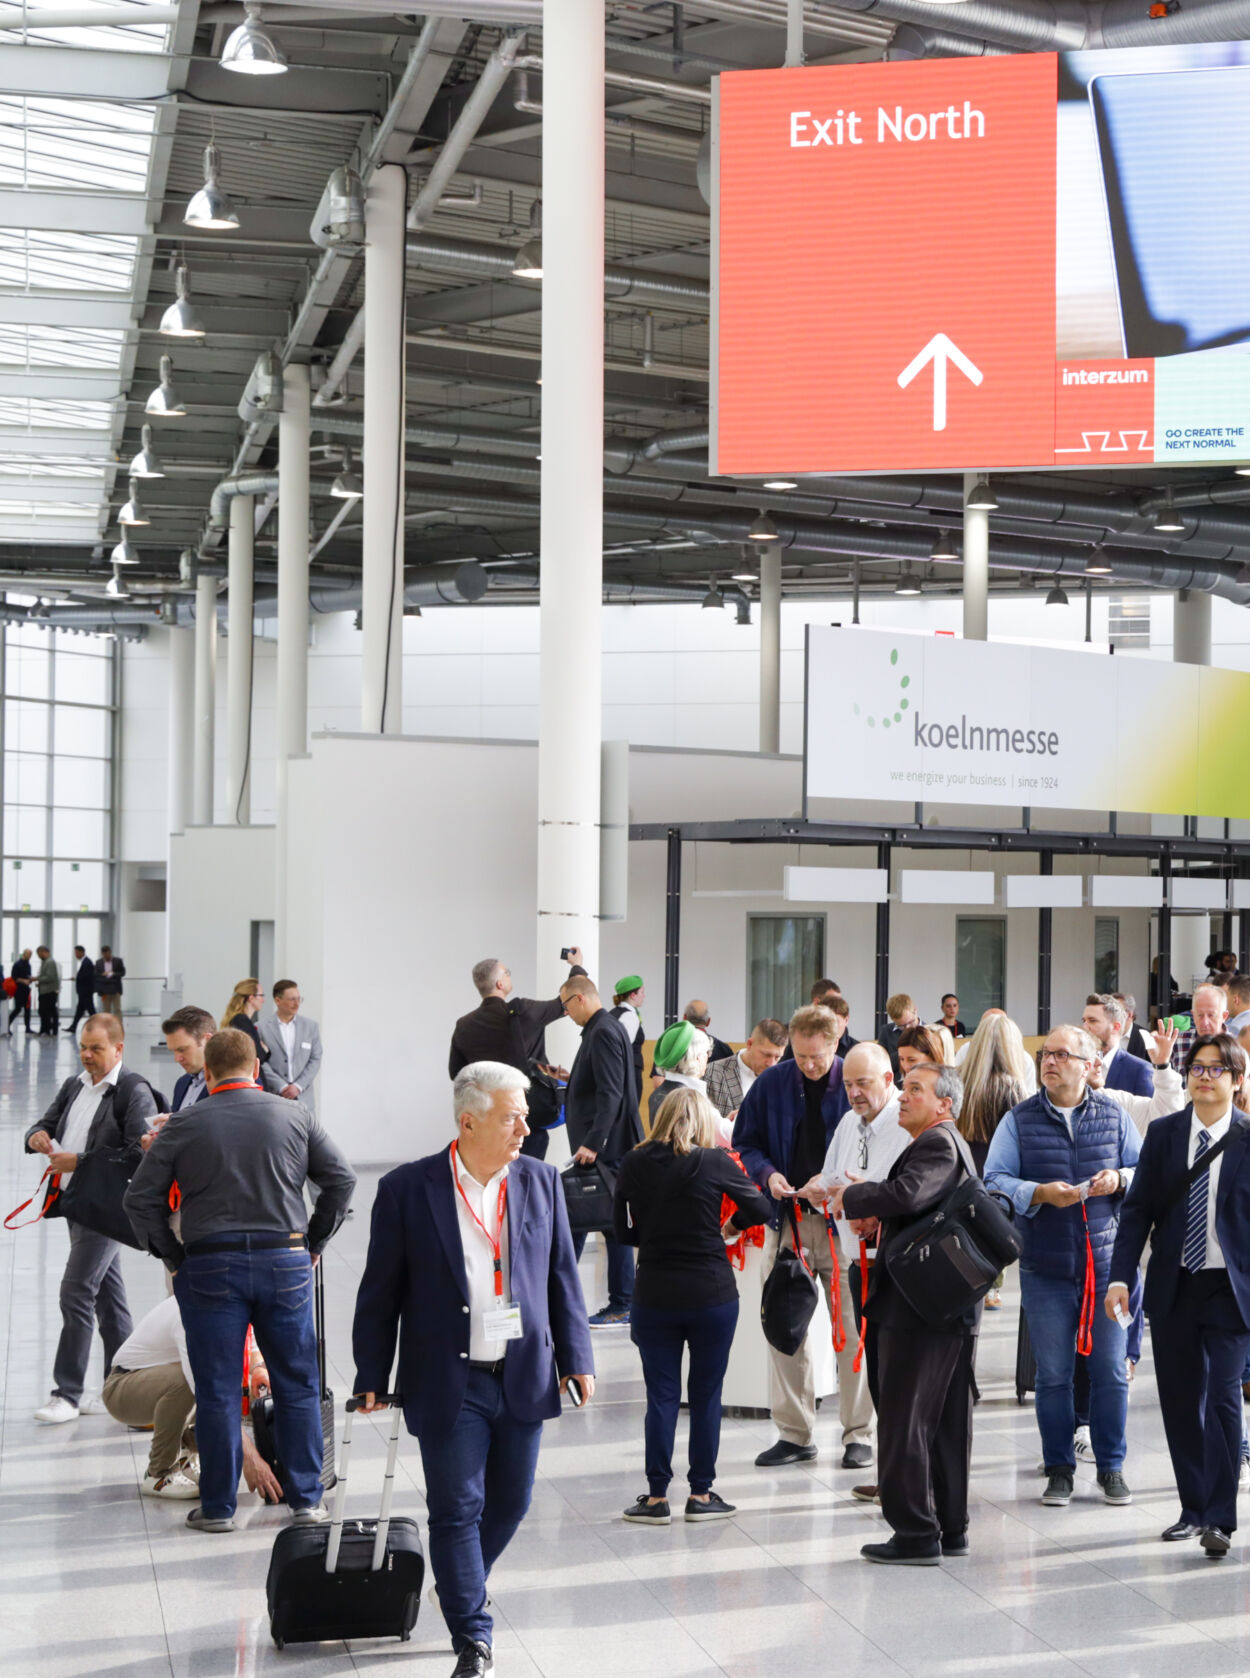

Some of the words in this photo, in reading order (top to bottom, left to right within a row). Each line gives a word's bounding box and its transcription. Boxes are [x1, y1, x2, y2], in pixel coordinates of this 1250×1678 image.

[790, 110, 863, 148] Exit
[877, 100, 985, 143] North
[1062, 368, 1149, 386] interzum
[1165, 429, 1183, 439] GO
[1184, 428, 1223, 438] CREATE
[1225, 427, 1245, 437] THE
[1165, 440, 1191, 450] NEXT
[1192, 439, 1237, 449] NORMAL
[914, 711, 1060, 756] koelnmesse
[889, 771, 905, 782] we
[906, 771, 945, 787] energize
[946, 774, 968, 788] your
[969, 772, 1007, 787] business
[1017, 775, 1039, 789] since
[1041, 776, 1060, 790] 1924
